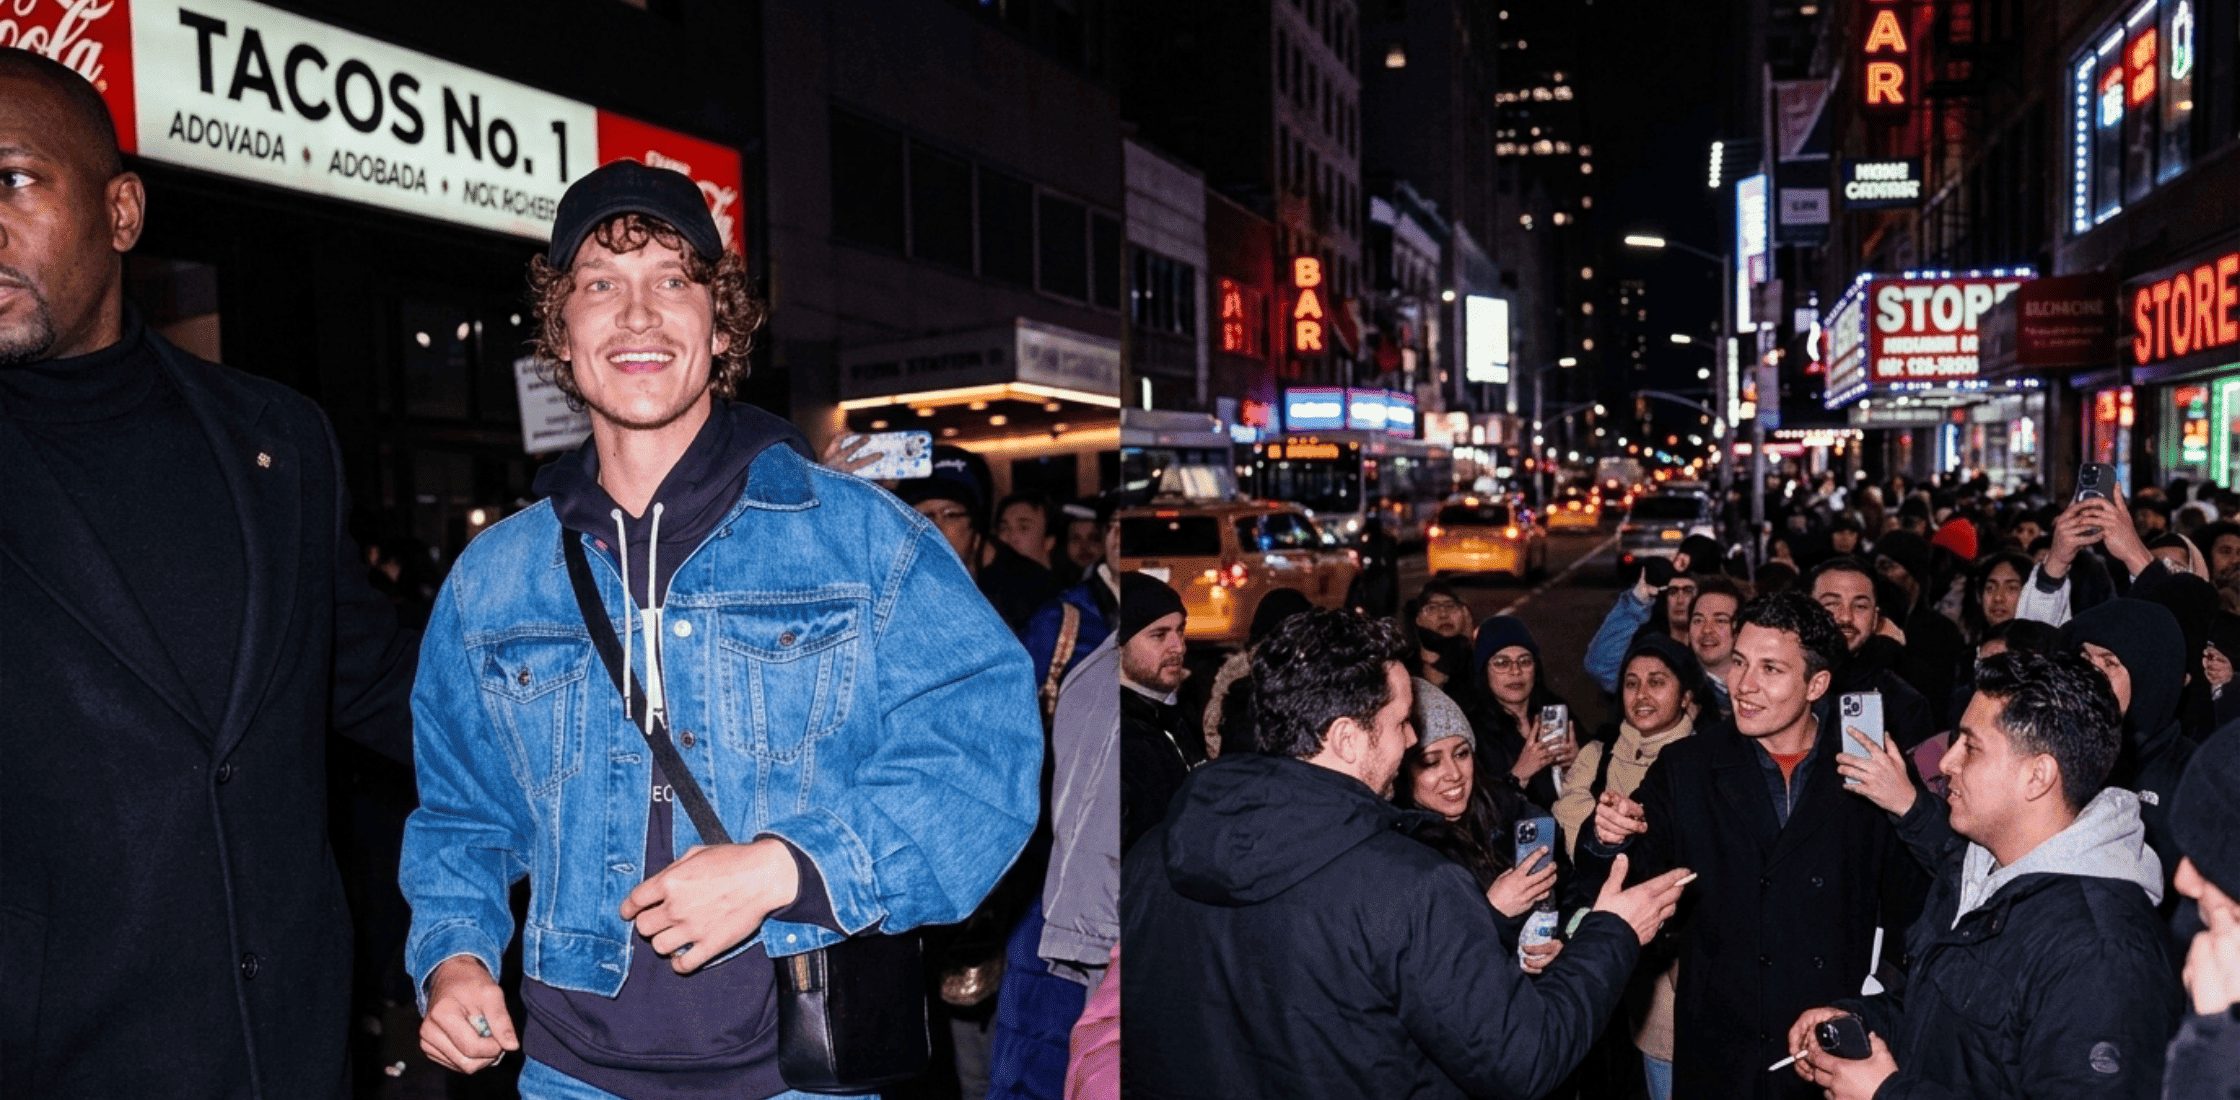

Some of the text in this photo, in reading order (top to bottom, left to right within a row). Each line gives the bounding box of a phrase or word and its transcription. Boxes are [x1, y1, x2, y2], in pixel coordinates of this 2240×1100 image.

[179, 7, 568, 183] TACOS No. 1
[1864, 0, 1907, 104] AR
[169, 110, 287, 164] ADOVADA
[328, 150, 428, 194] ADOBADA
[1294, 256, 1323, 351] BAR
[2134, 253, 2239, 365] STORE
